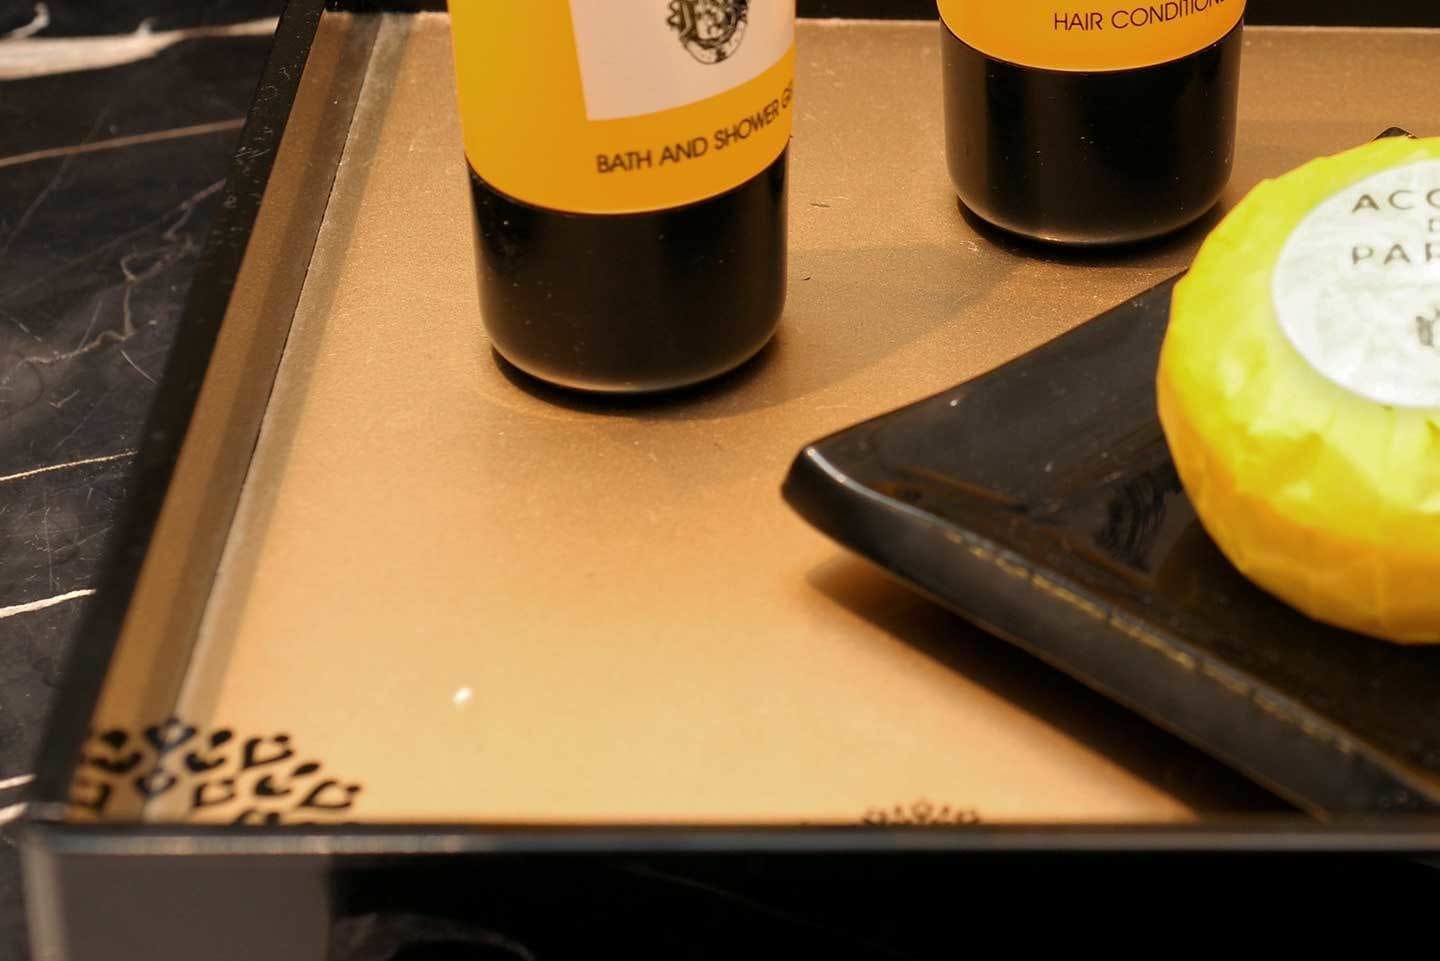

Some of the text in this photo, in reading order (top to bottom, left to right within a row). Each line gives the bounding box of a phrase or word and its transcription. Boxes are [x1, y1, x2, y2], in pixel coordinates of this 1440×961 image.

[1054, 12, 1103, 31] HAIR
[596, 149, 653, 174] BATH
[658, 137, 708, 166] AND
[714, 99, 779, 150] SHOWER
